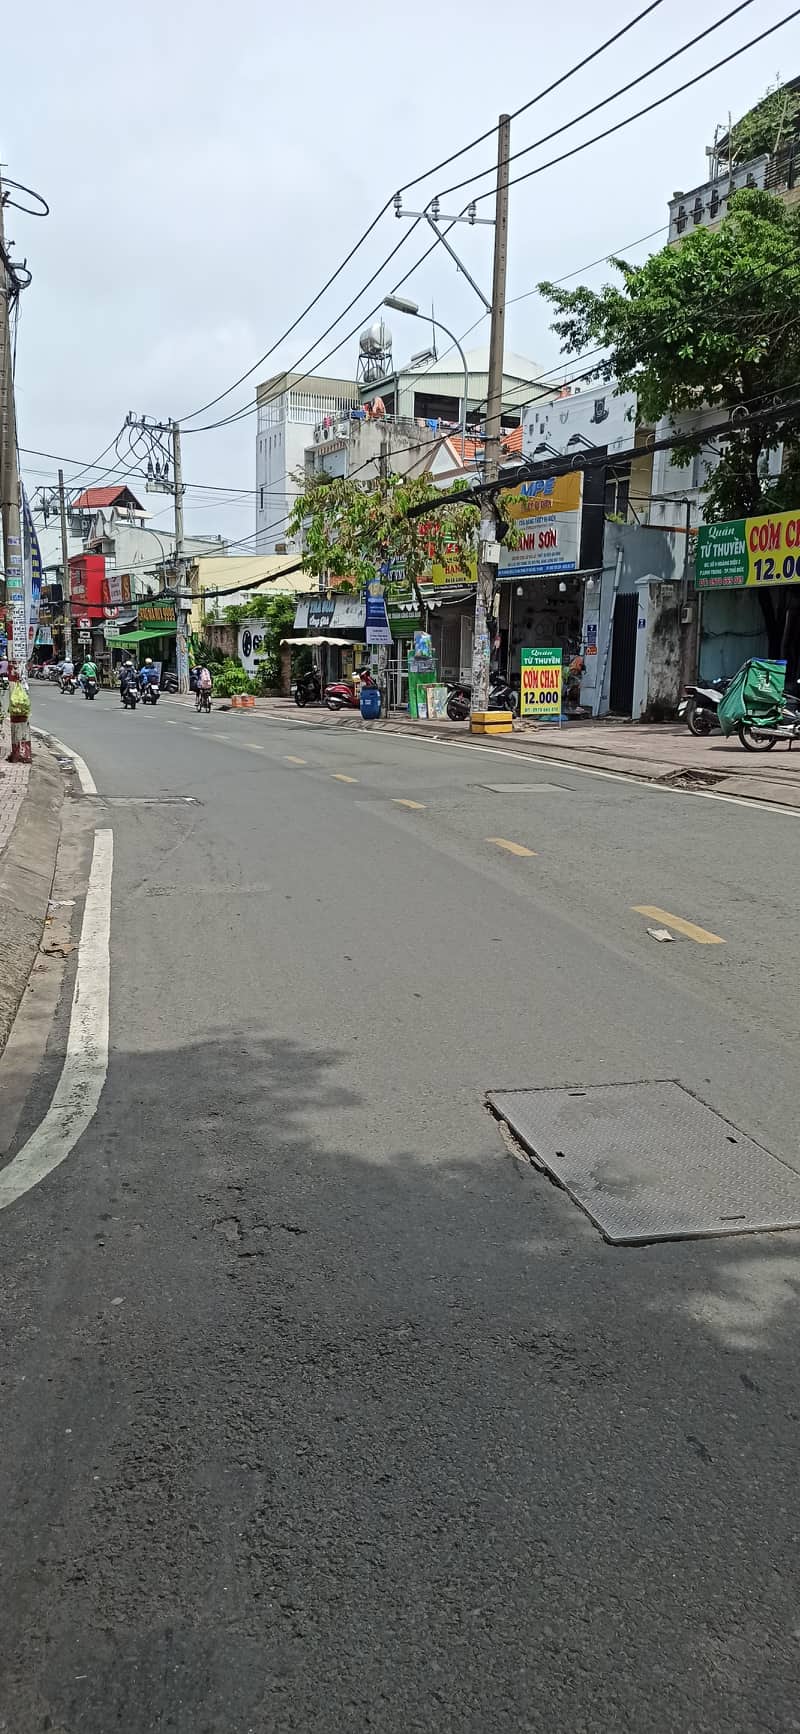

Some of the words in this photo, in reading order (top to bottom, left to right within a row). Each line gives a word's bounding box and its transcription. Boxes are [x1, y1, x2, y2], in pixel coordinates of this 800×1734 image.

[521, 478, 555, 496] MPE
[708, 526, 735, 539] Quán
[749, 519, 781, 553] CƠM
[713, 537, 745, 557] THUYỀN
[534, 656, 561, 664] THUYỀN
[523, 667, 539, 689] CƠM
[540, 670, 560, 688] CHAY
[523, 691, 559, 704] 12.000
